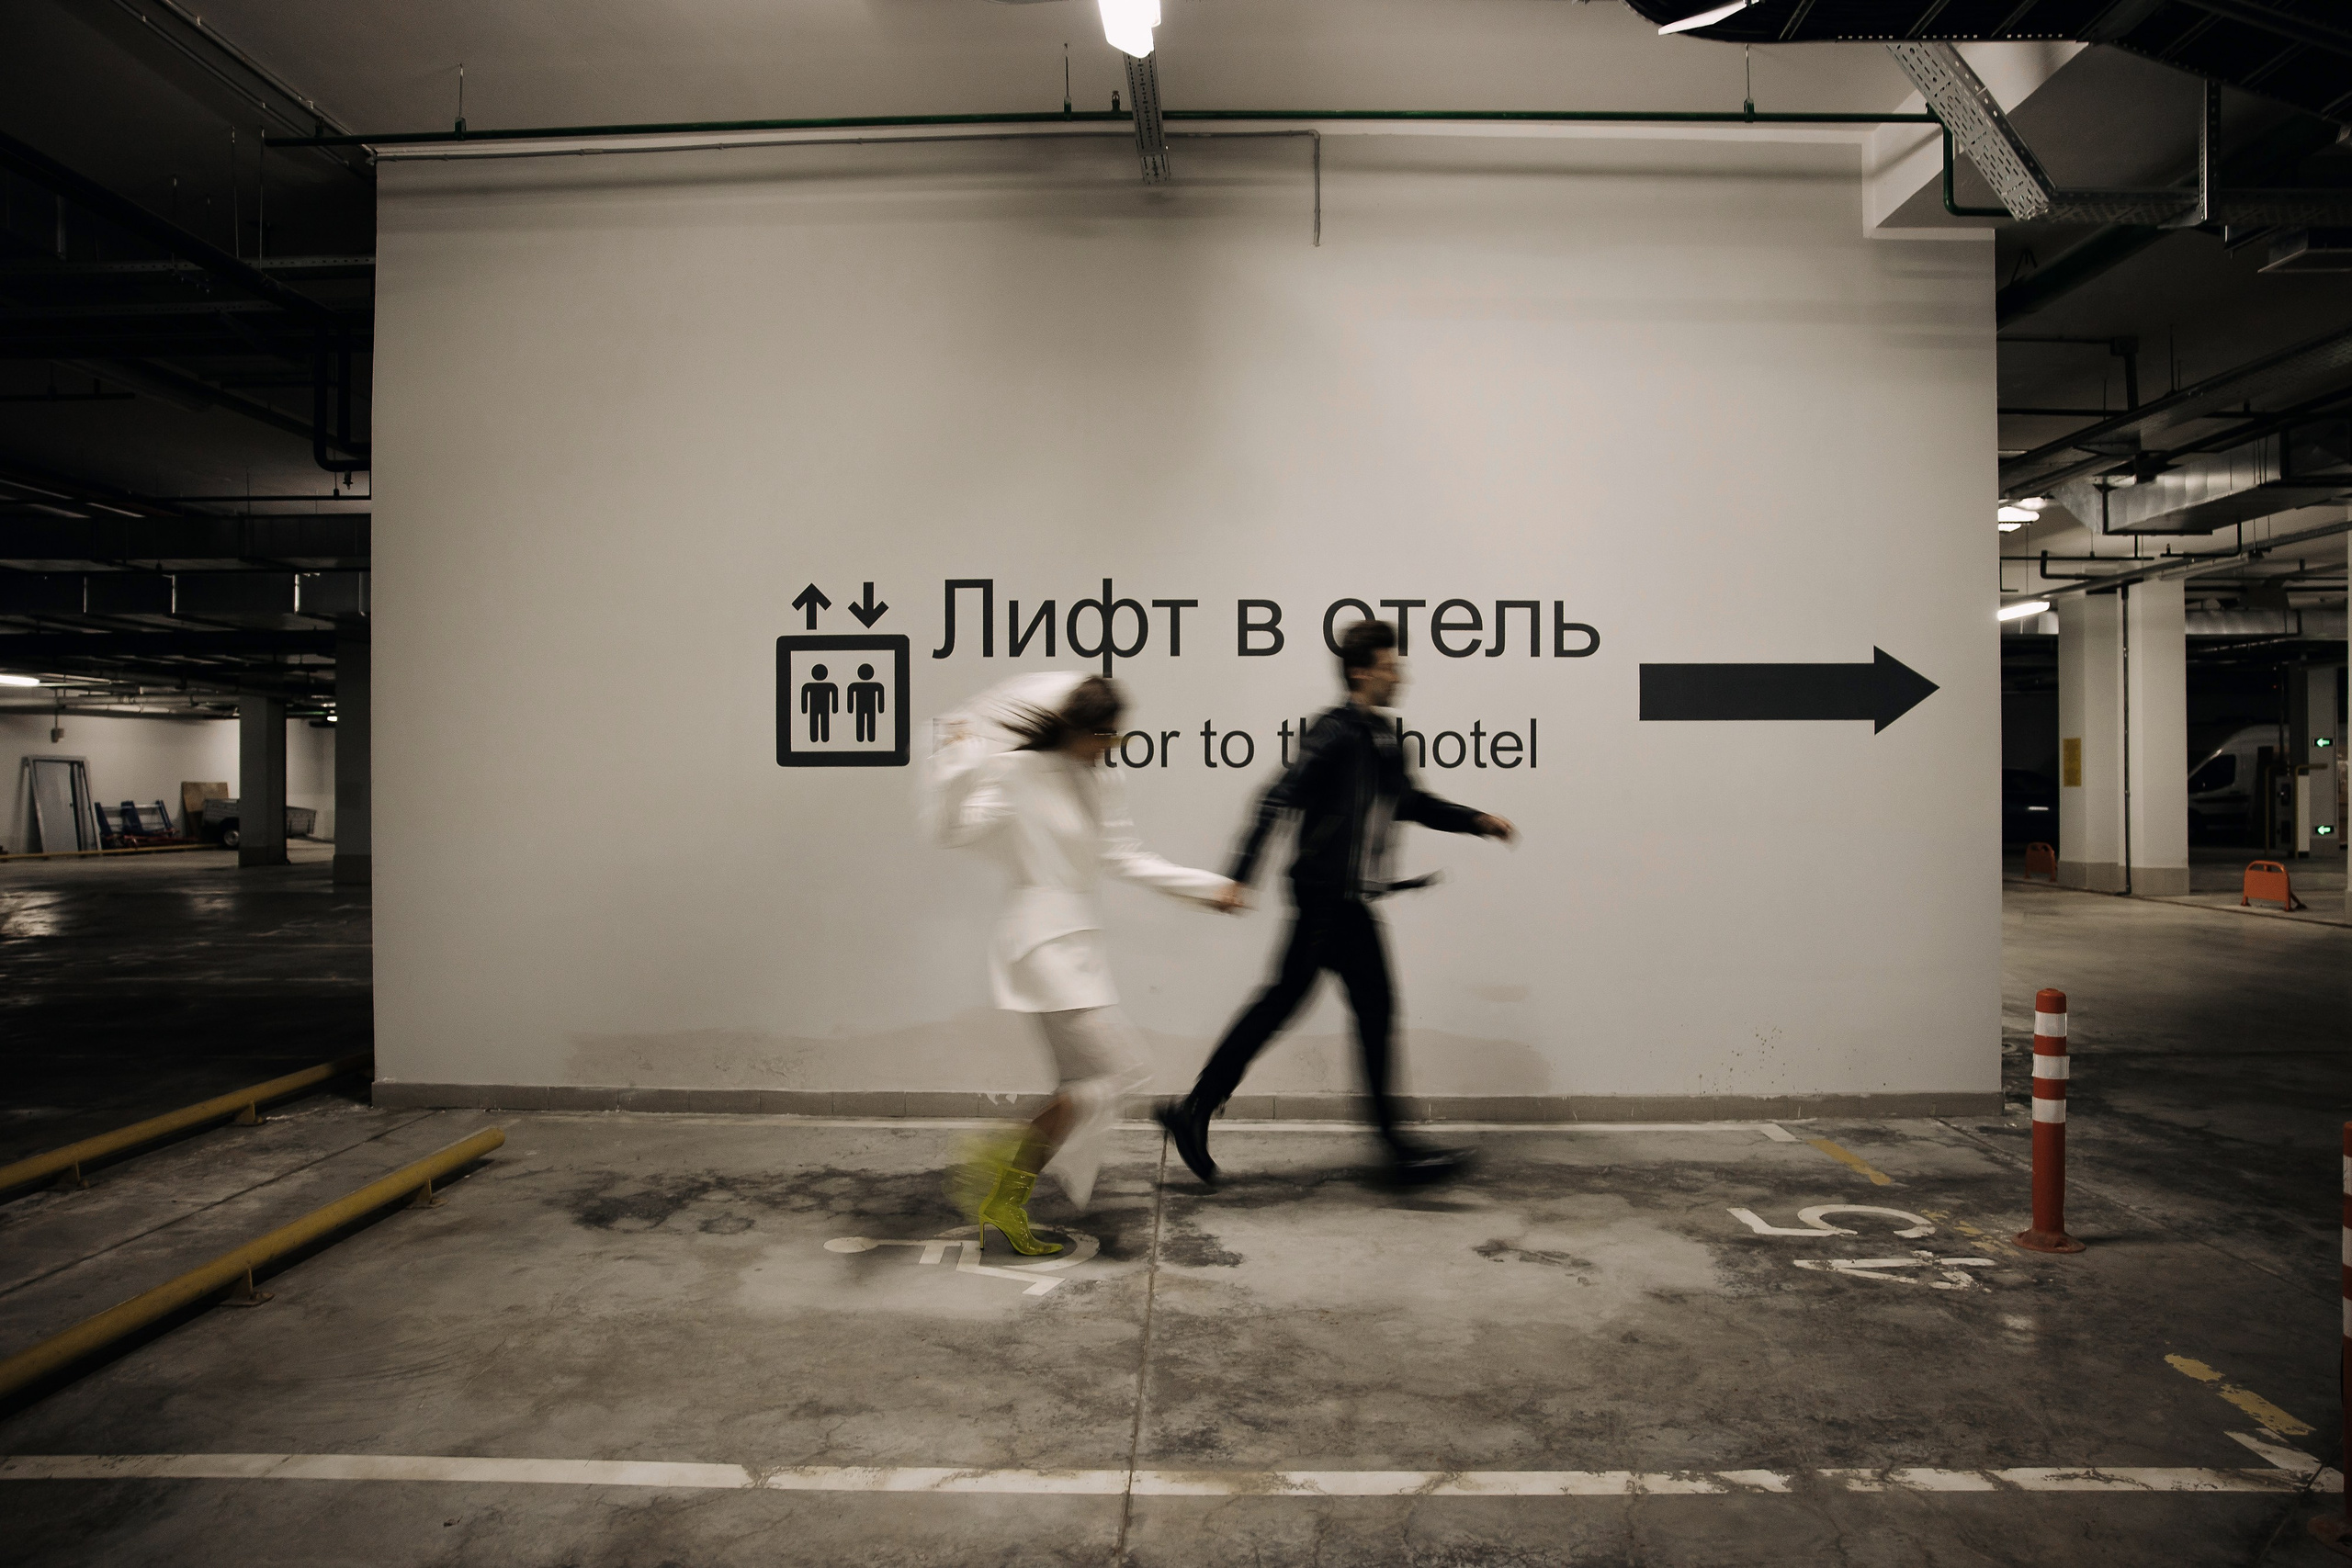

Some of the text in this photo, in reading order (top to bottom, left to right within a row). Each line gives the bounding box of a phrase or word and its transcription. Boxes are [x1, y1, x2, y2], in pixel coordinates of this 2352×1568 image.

[932, 578, 1600, 677] Лифт в отель
[1199, 718, 1255, 769] to
[1396, 717, 1537, 769] hotel
